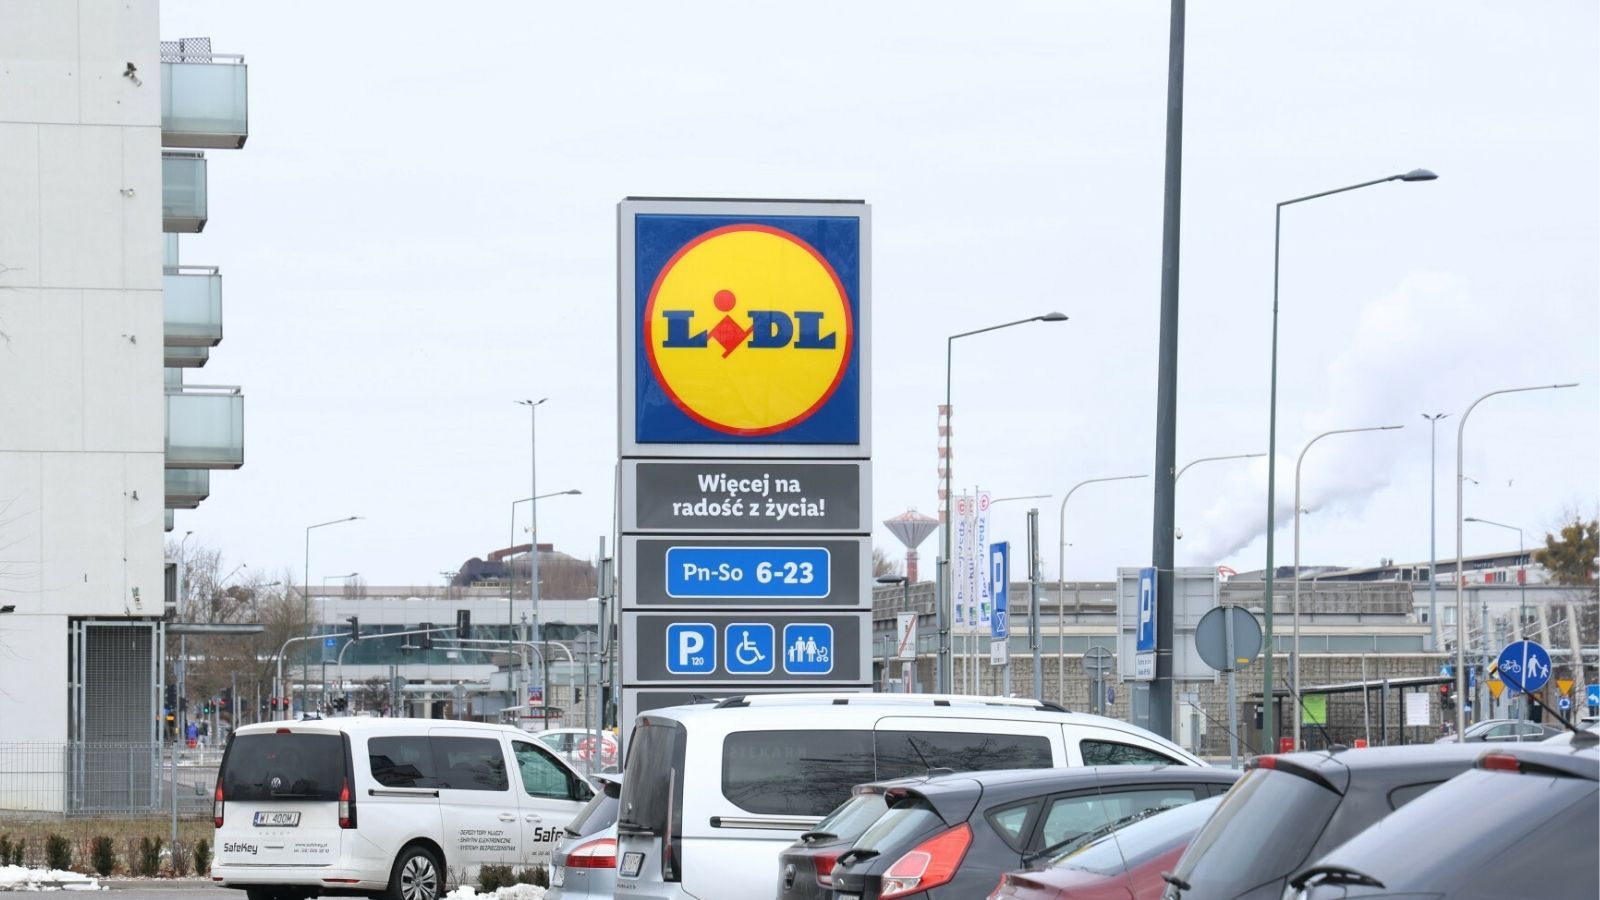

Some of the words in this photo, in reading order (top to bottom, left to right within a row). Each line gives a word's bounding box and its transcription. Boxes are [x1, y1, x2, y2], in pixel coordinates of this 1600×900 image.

[698, 473, 770, 497] Więcej
[774, 479, 801, 493] na
[672, 498, 743, 516] radość
[749, 503, 760, 516] z
[765, 498, 825, 520] życia!
[683, 563, 743, 581] Pn-So
[756, 562, 814, 584] 6-23
[1140, 578, 1152, 641] P
[679, 631, 704, 666] P
[691, 656, 704, 666] 120
[224, 842, 258, 855] SafeKey
